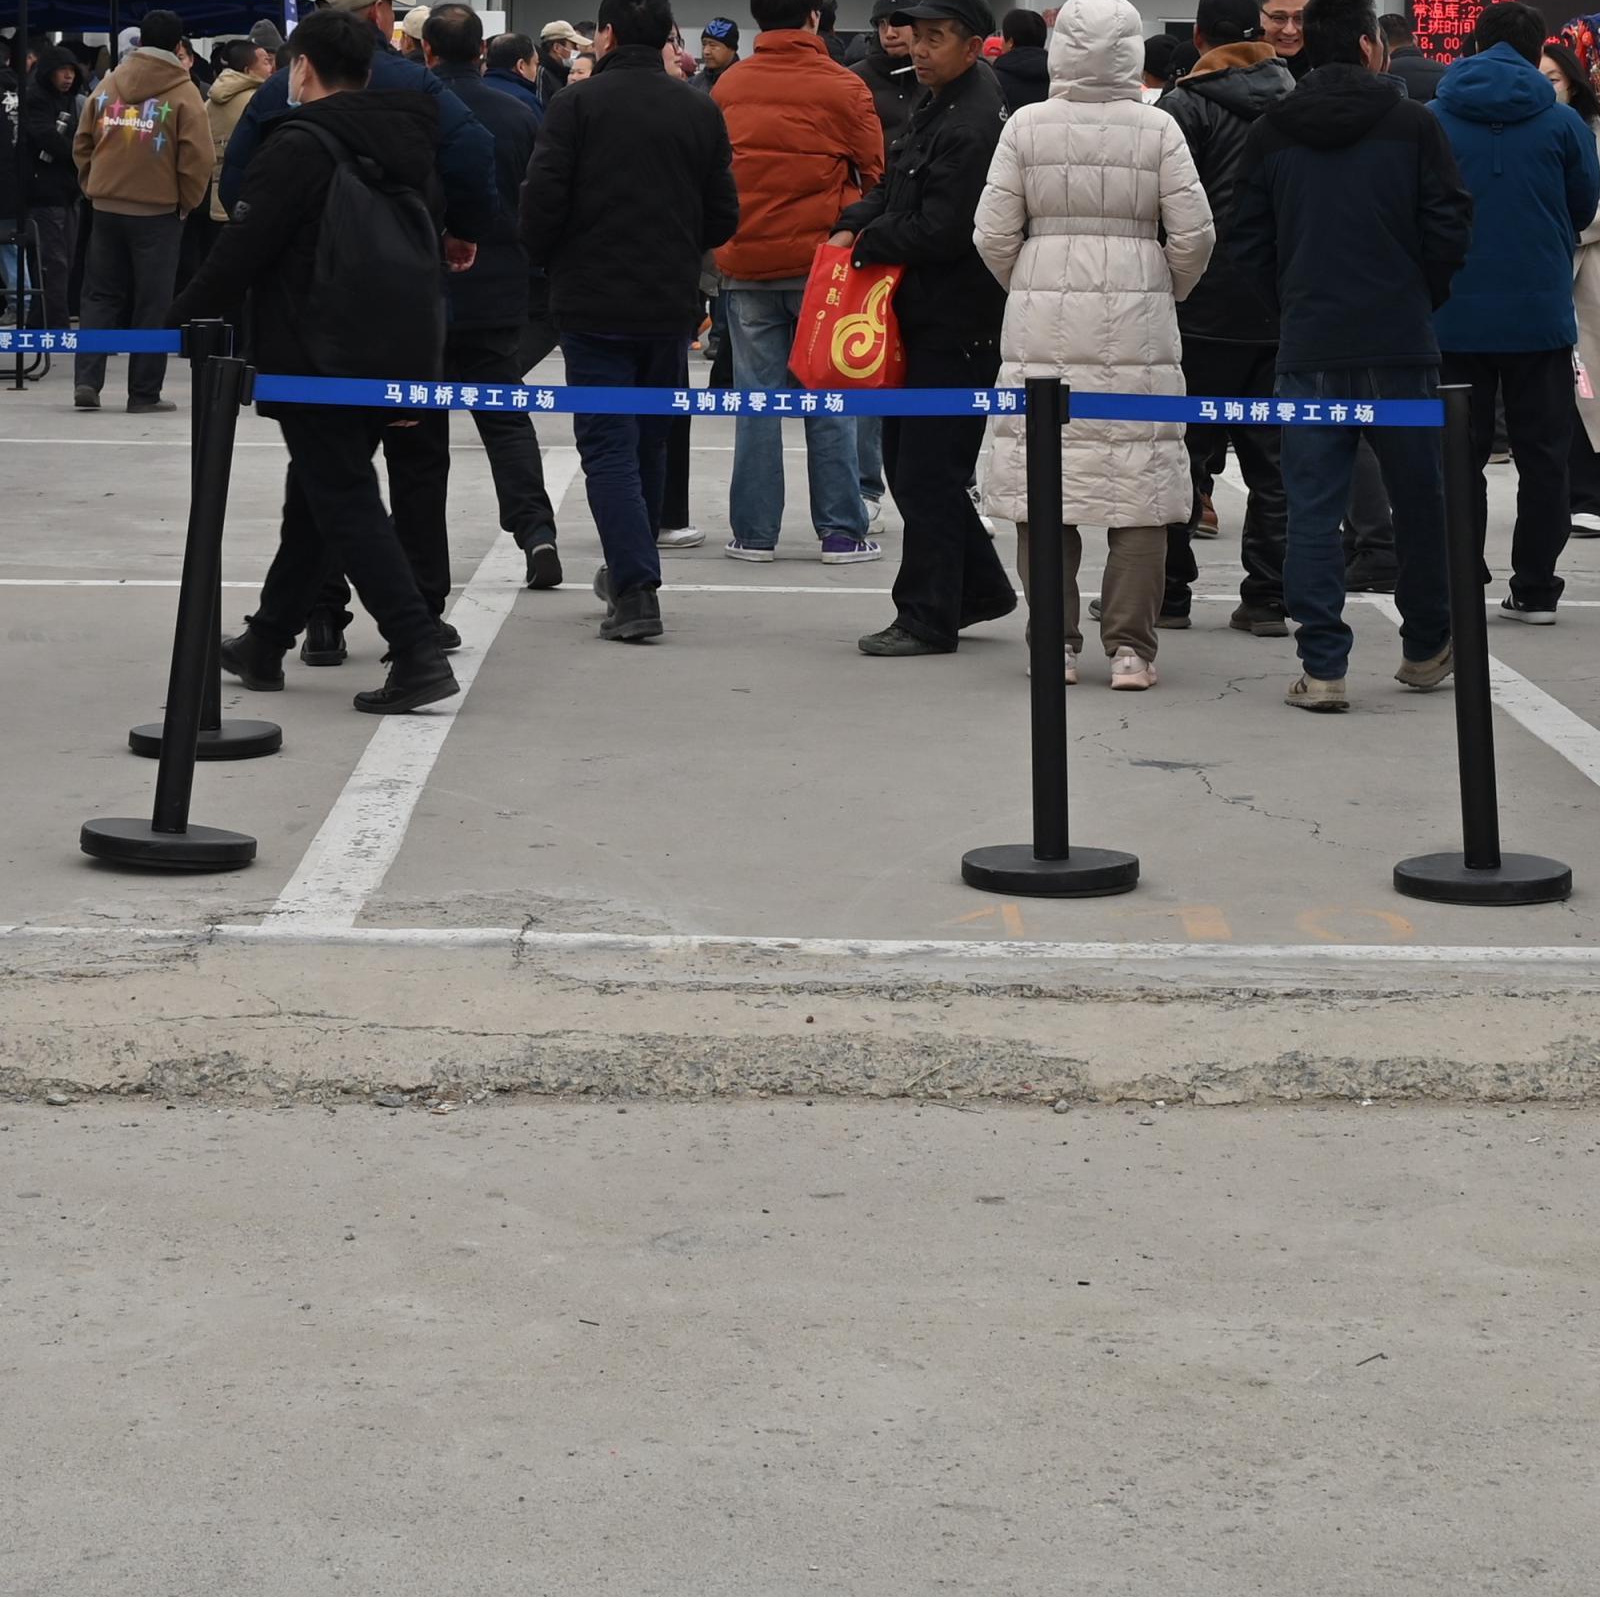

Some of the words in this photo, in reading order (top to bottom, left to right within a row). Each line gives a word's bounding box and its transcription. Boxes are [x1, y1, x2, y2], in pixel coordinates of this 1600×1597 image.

[383, 382, 557, 410] 马驹桥零工市场
[671, 391, 845, 412] 马驹桥零工市场
[972, 390, 1027, 411] 马驹
[1199, 400, 1376, 424] 马驹桥零工市场
